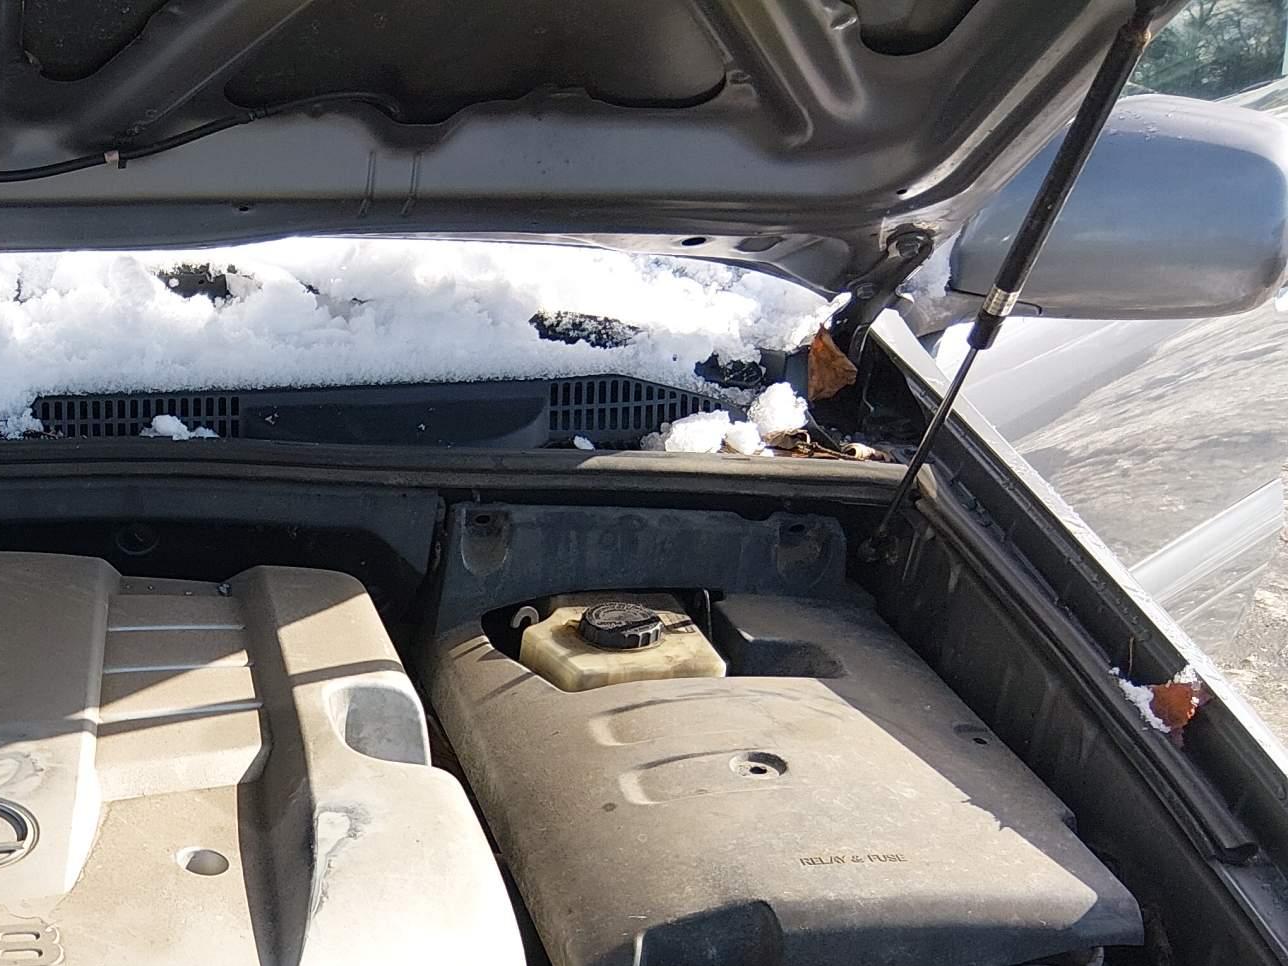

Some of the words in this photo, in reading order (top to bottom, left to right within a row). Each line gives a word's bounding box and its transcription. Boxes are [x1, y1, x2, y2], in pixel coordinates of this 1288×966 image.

[799, 855, 847, 866] RELAY
[850, 854, 865, 864] &
[866, 853, 909, 863] FUSE
